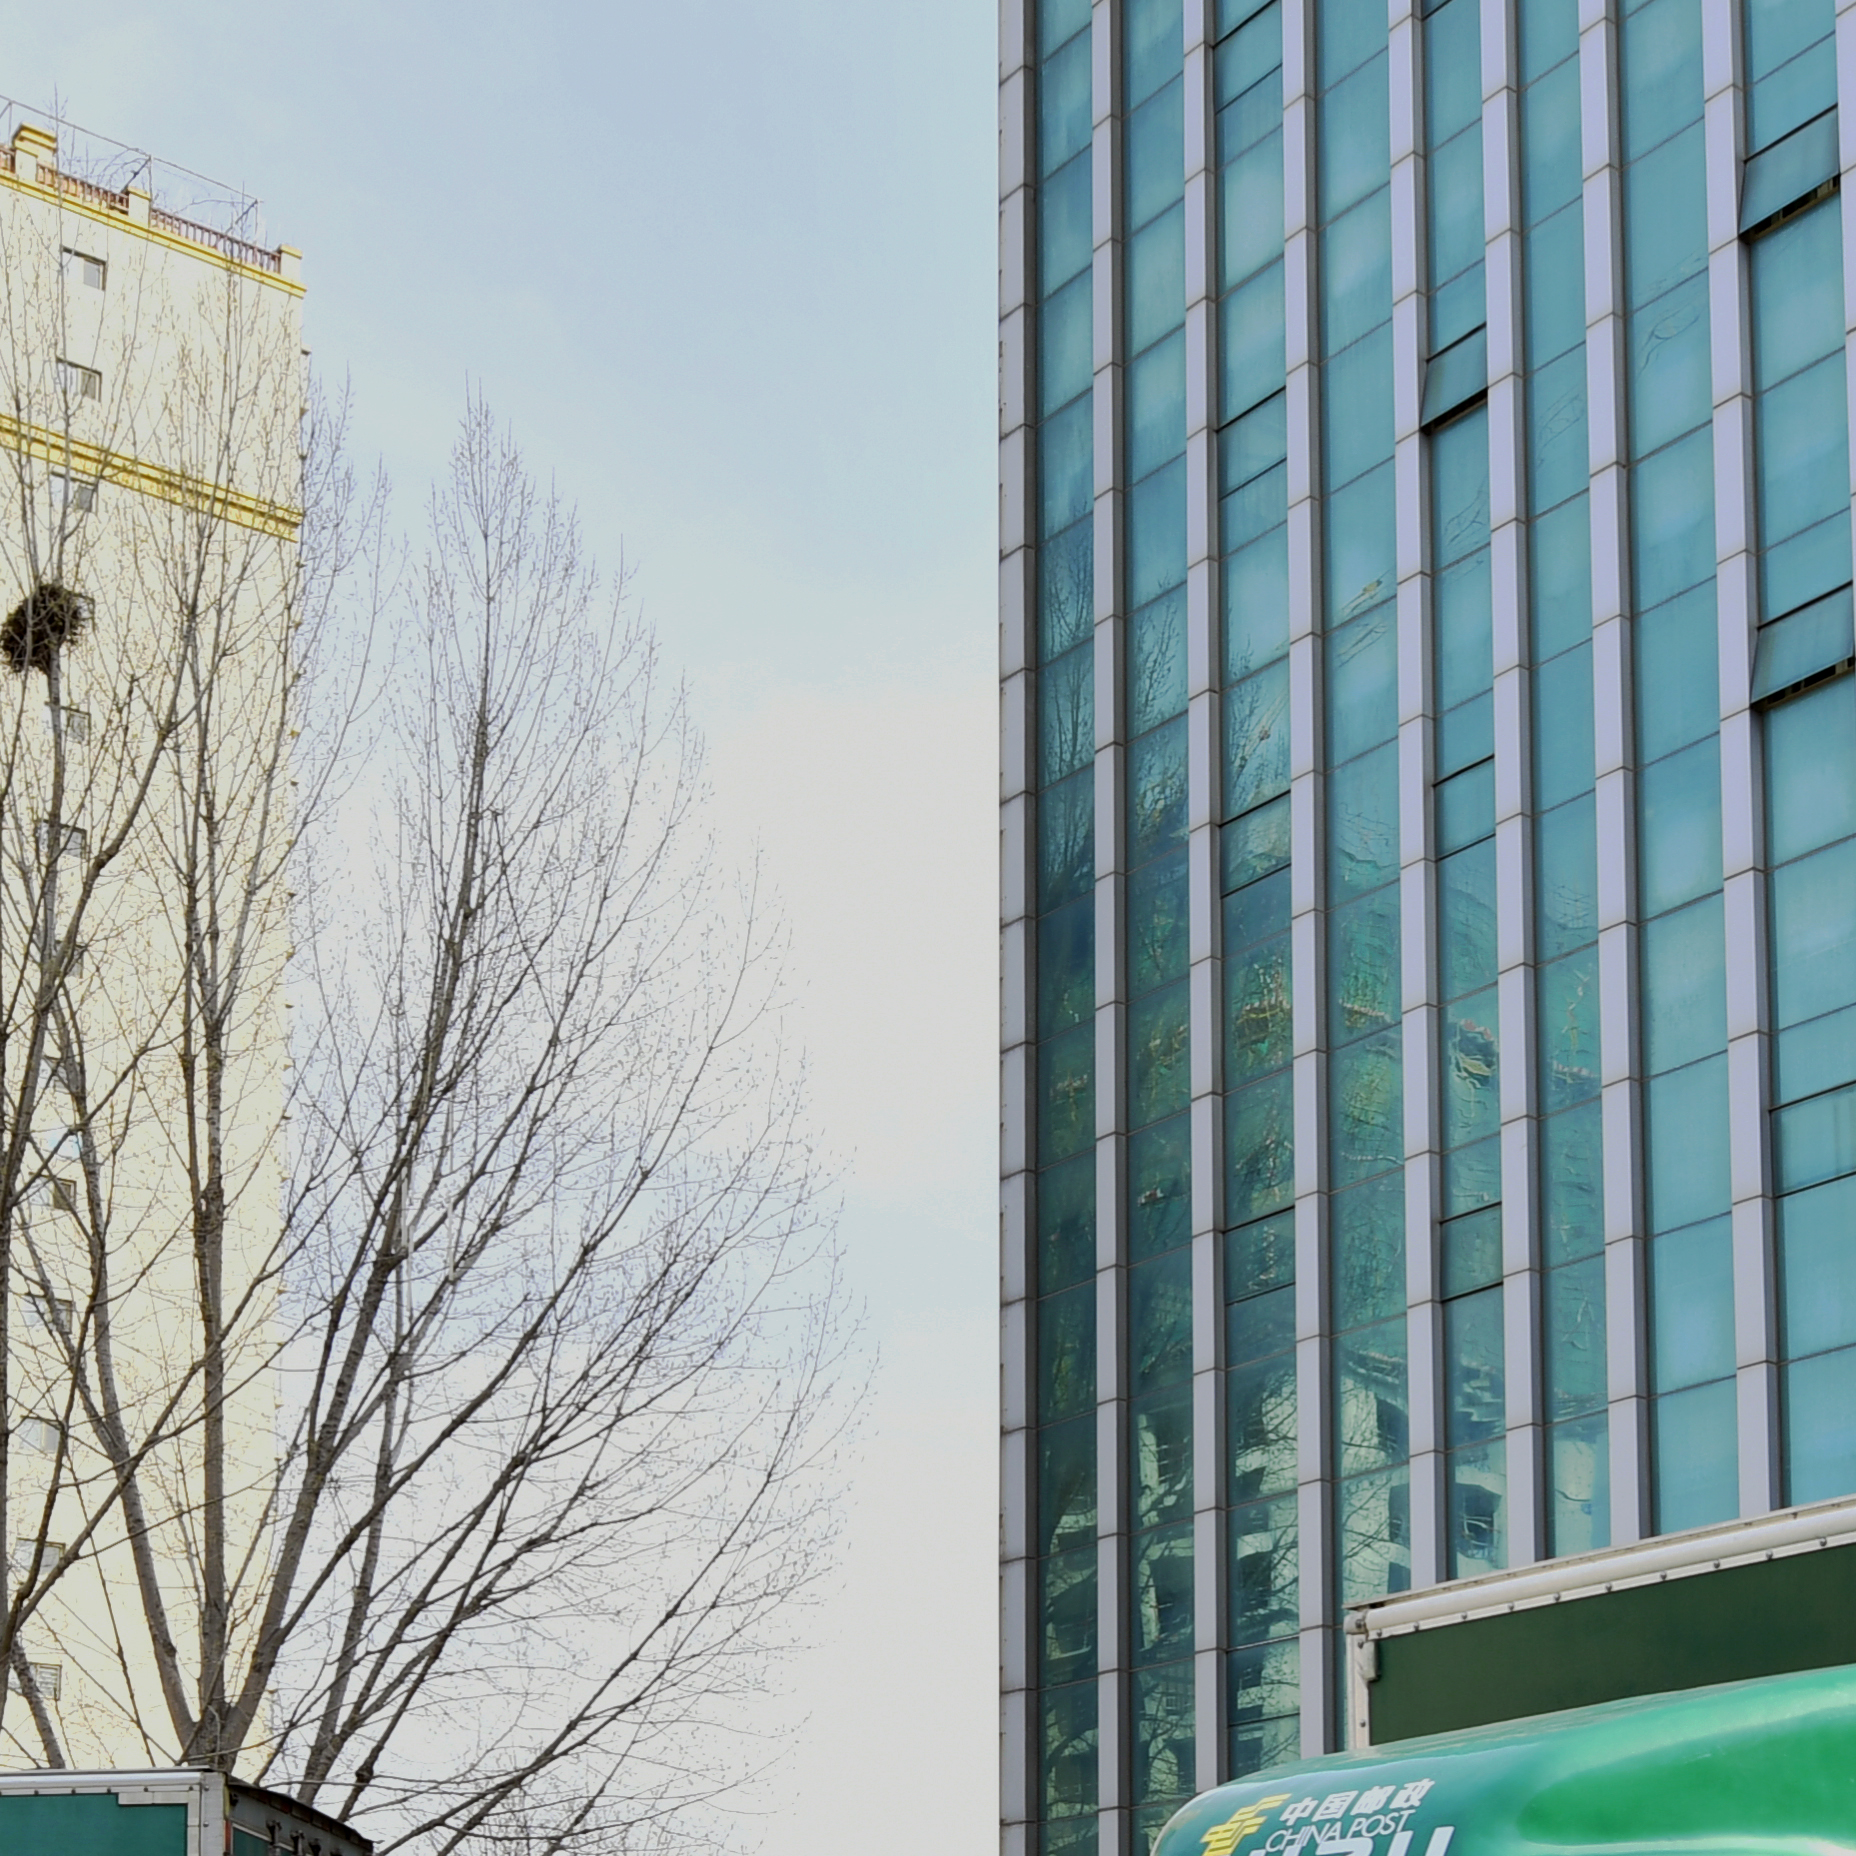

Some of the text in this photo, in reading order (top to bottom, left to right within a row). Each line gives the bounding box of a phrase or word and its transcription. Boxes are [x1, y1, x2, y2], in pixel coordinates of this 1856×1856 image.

[1279, 1777, 1435, 1826] 中国邮政
[1265, 1809, 1416, 1852] CHINA POST
